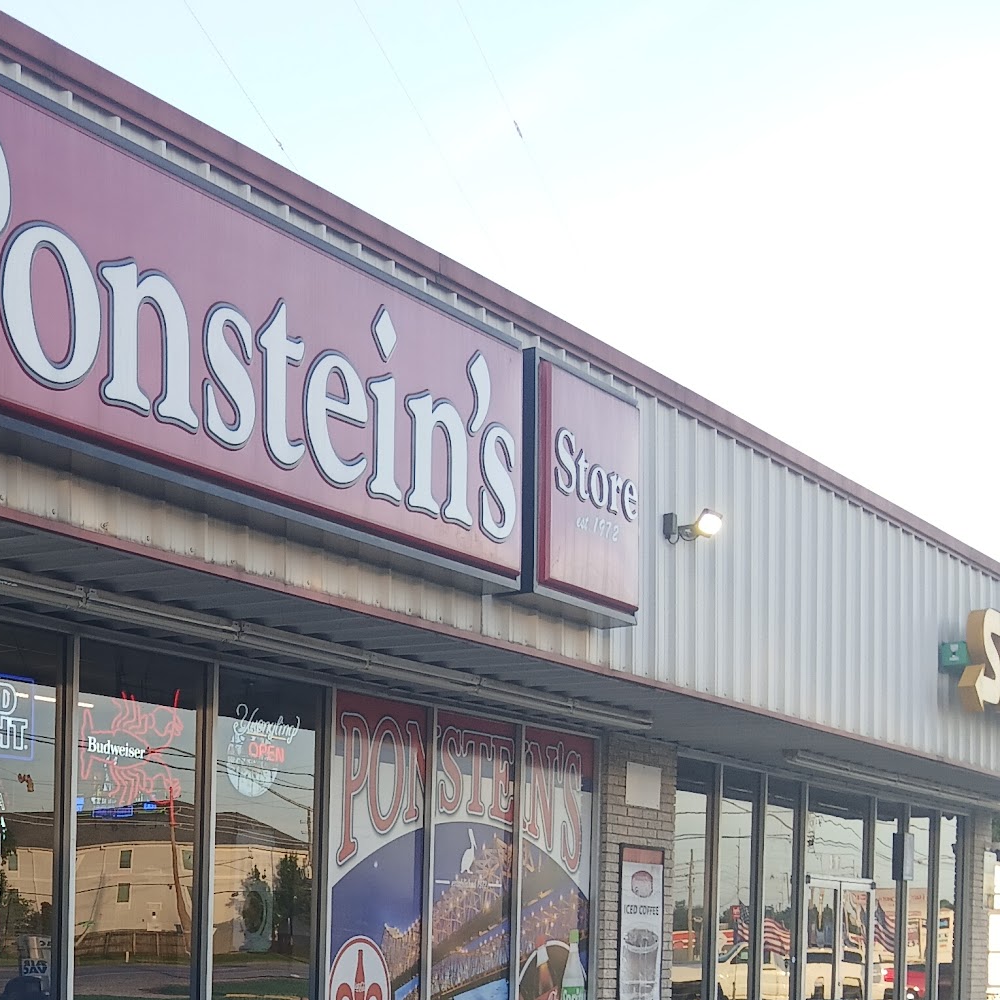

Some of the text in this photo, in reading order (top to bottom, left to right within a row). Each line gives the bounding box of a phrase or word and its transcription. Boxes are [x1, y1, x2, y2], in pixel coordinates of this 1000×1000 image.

[553, 426, 639, 523] Store
[593, 517, 621, 542] 1972
[232, 703, 301, 744] Yuengling
[87, 736, 146, 759] Budweiser
[247, 741, 286, 763] OPEN
[624, 905, 660, 916] ICED COFFEE
